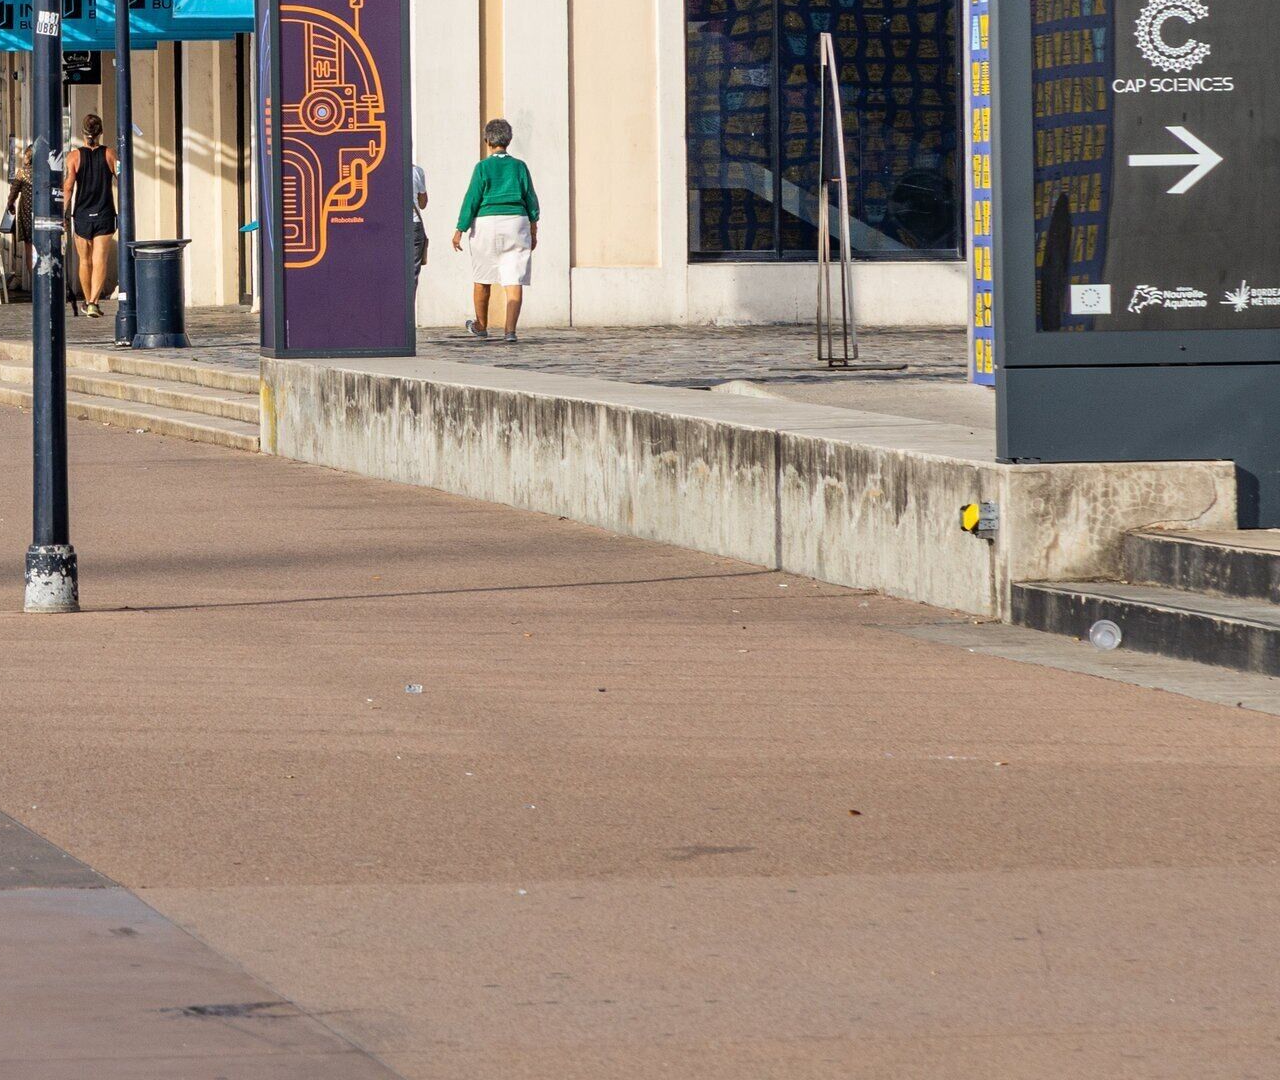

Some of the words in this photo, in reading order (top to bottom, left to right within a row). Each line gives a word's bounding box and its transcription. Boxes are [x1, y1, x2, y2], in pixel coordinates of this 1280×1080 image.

[1112, 78, 1146, 93] CAP
[1149, 76, 1234, 92] SCIENCES
[1163, 290, 1208, 299] Nouvelle-
[1163, 299, 1208, 310] Aquitaine
